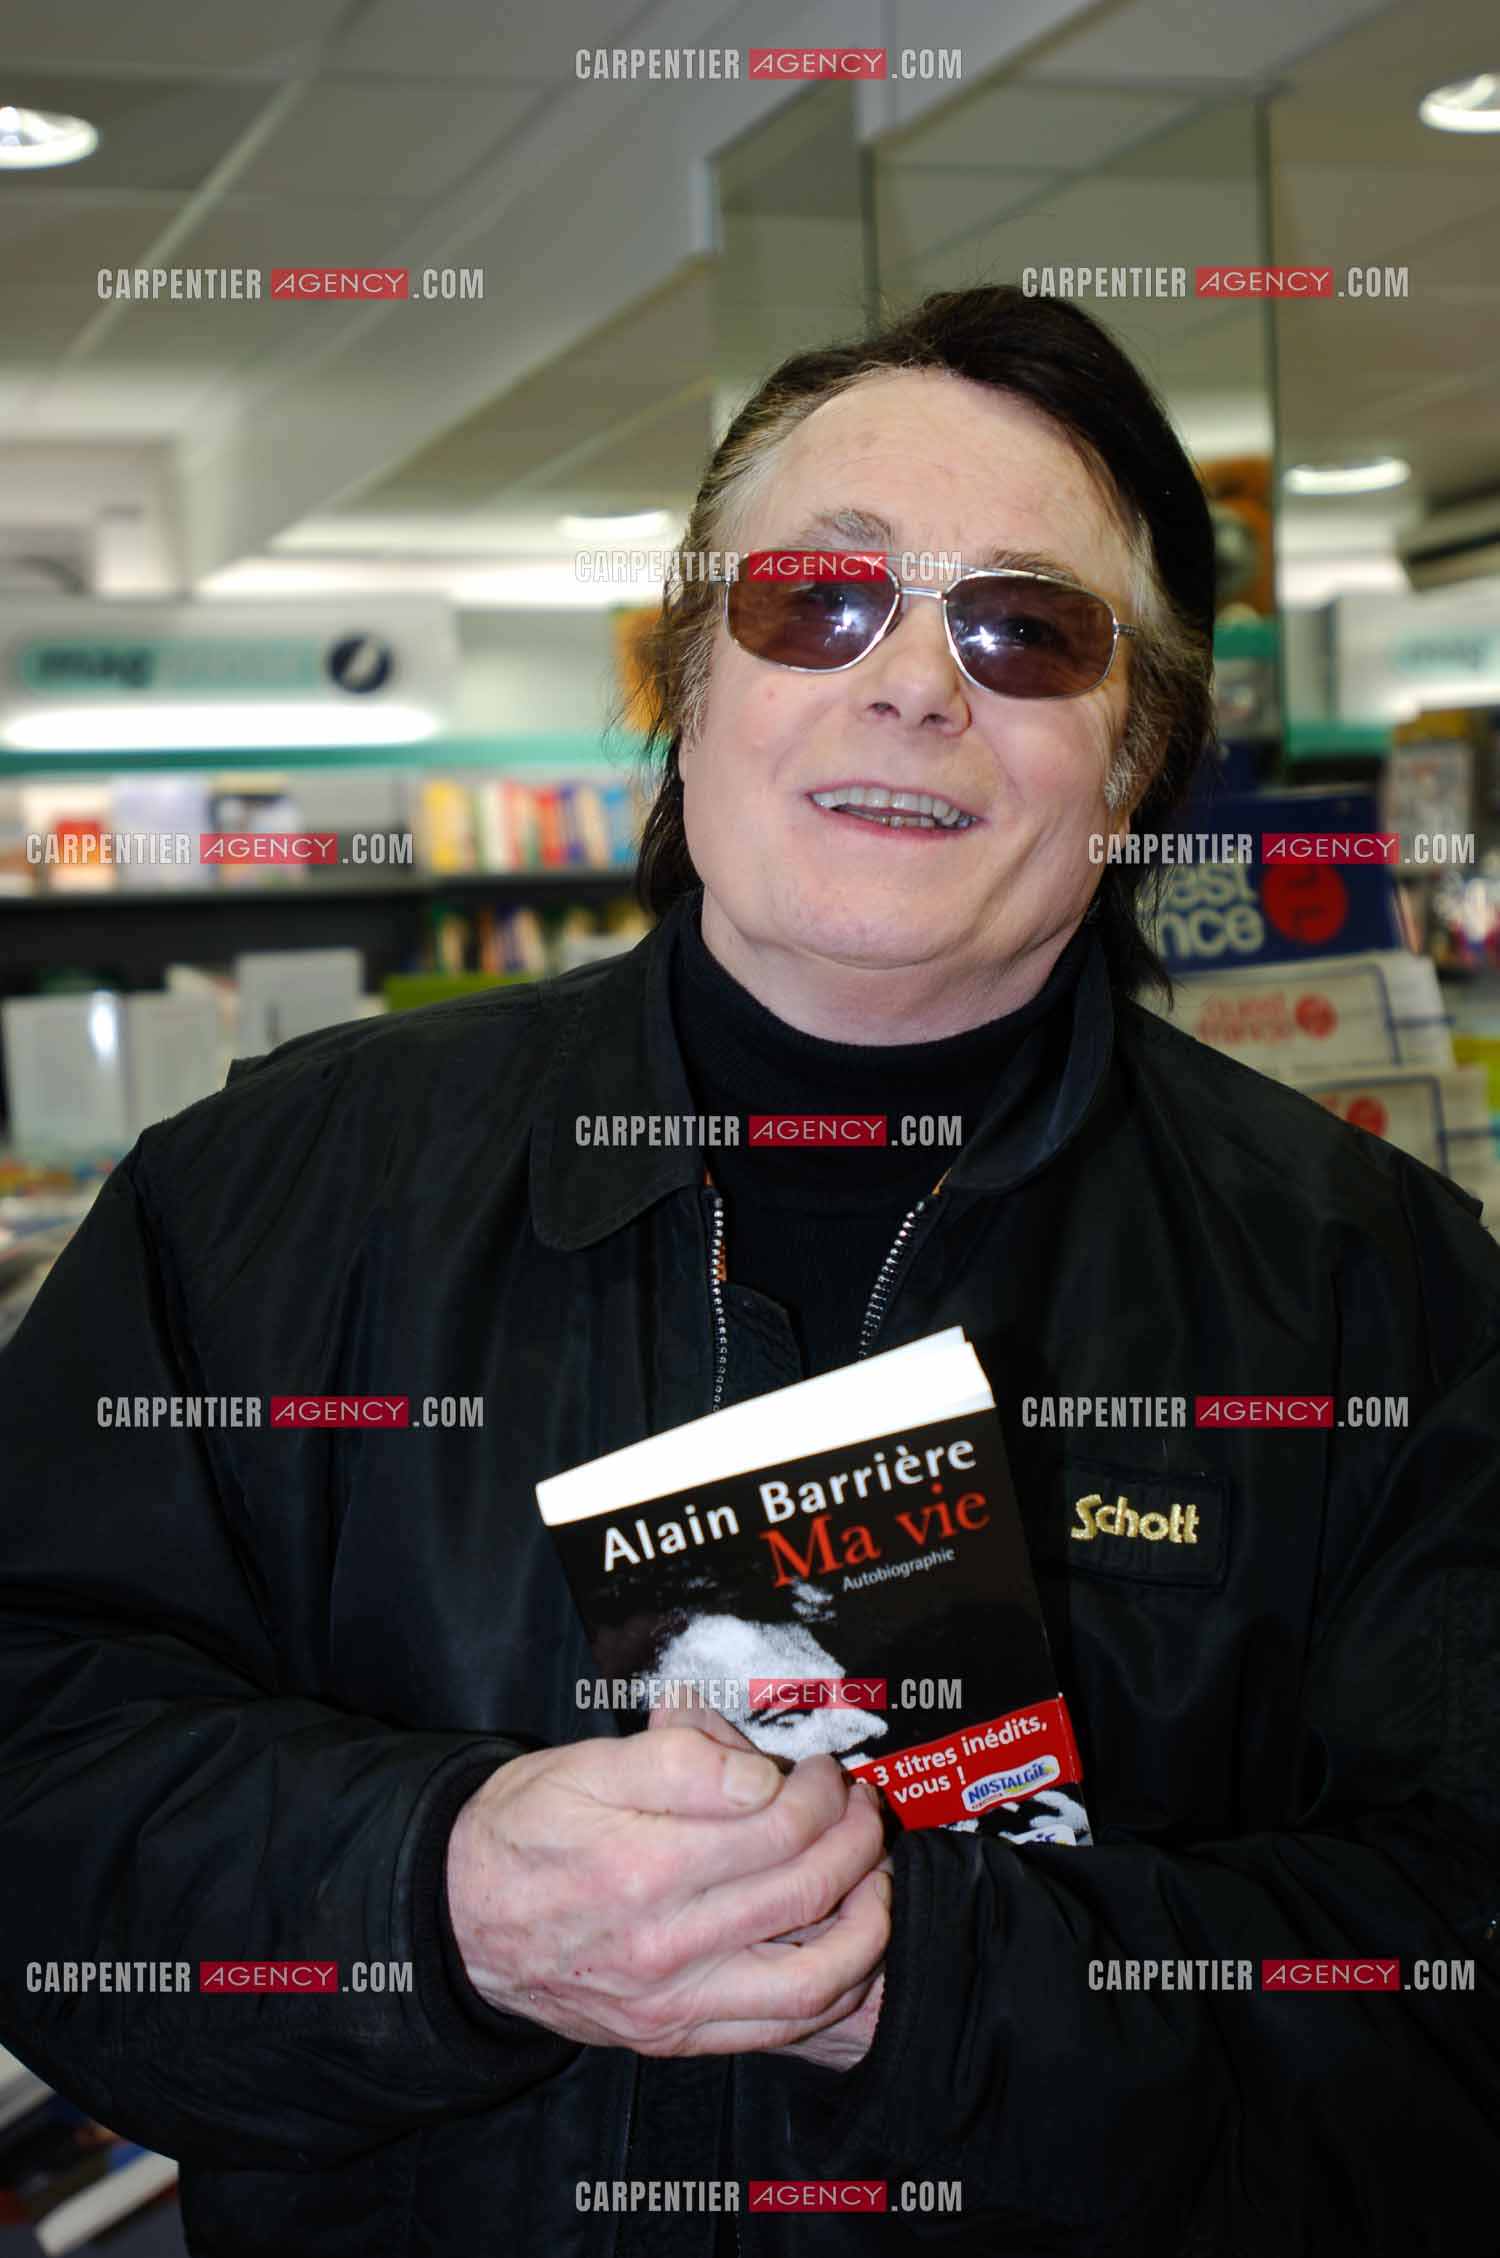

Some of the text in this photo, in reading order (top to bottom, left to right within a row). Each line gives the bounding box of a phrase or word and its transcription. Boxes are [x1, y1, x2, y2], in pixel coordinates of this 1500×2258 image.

[603, 1438, 977, 1572] Alain Barrière
[759, 1482, 991, 1588] Ma vie
[1070, 1493, 1200, 1544] Schott
[842, 1547, 956, 1593] Autobiographie
[873, 1714, 1048, 1787] 3 titres inédits,
[893, 1777, 951, 1804] vous
[956, 1765, 967, 1786] !
